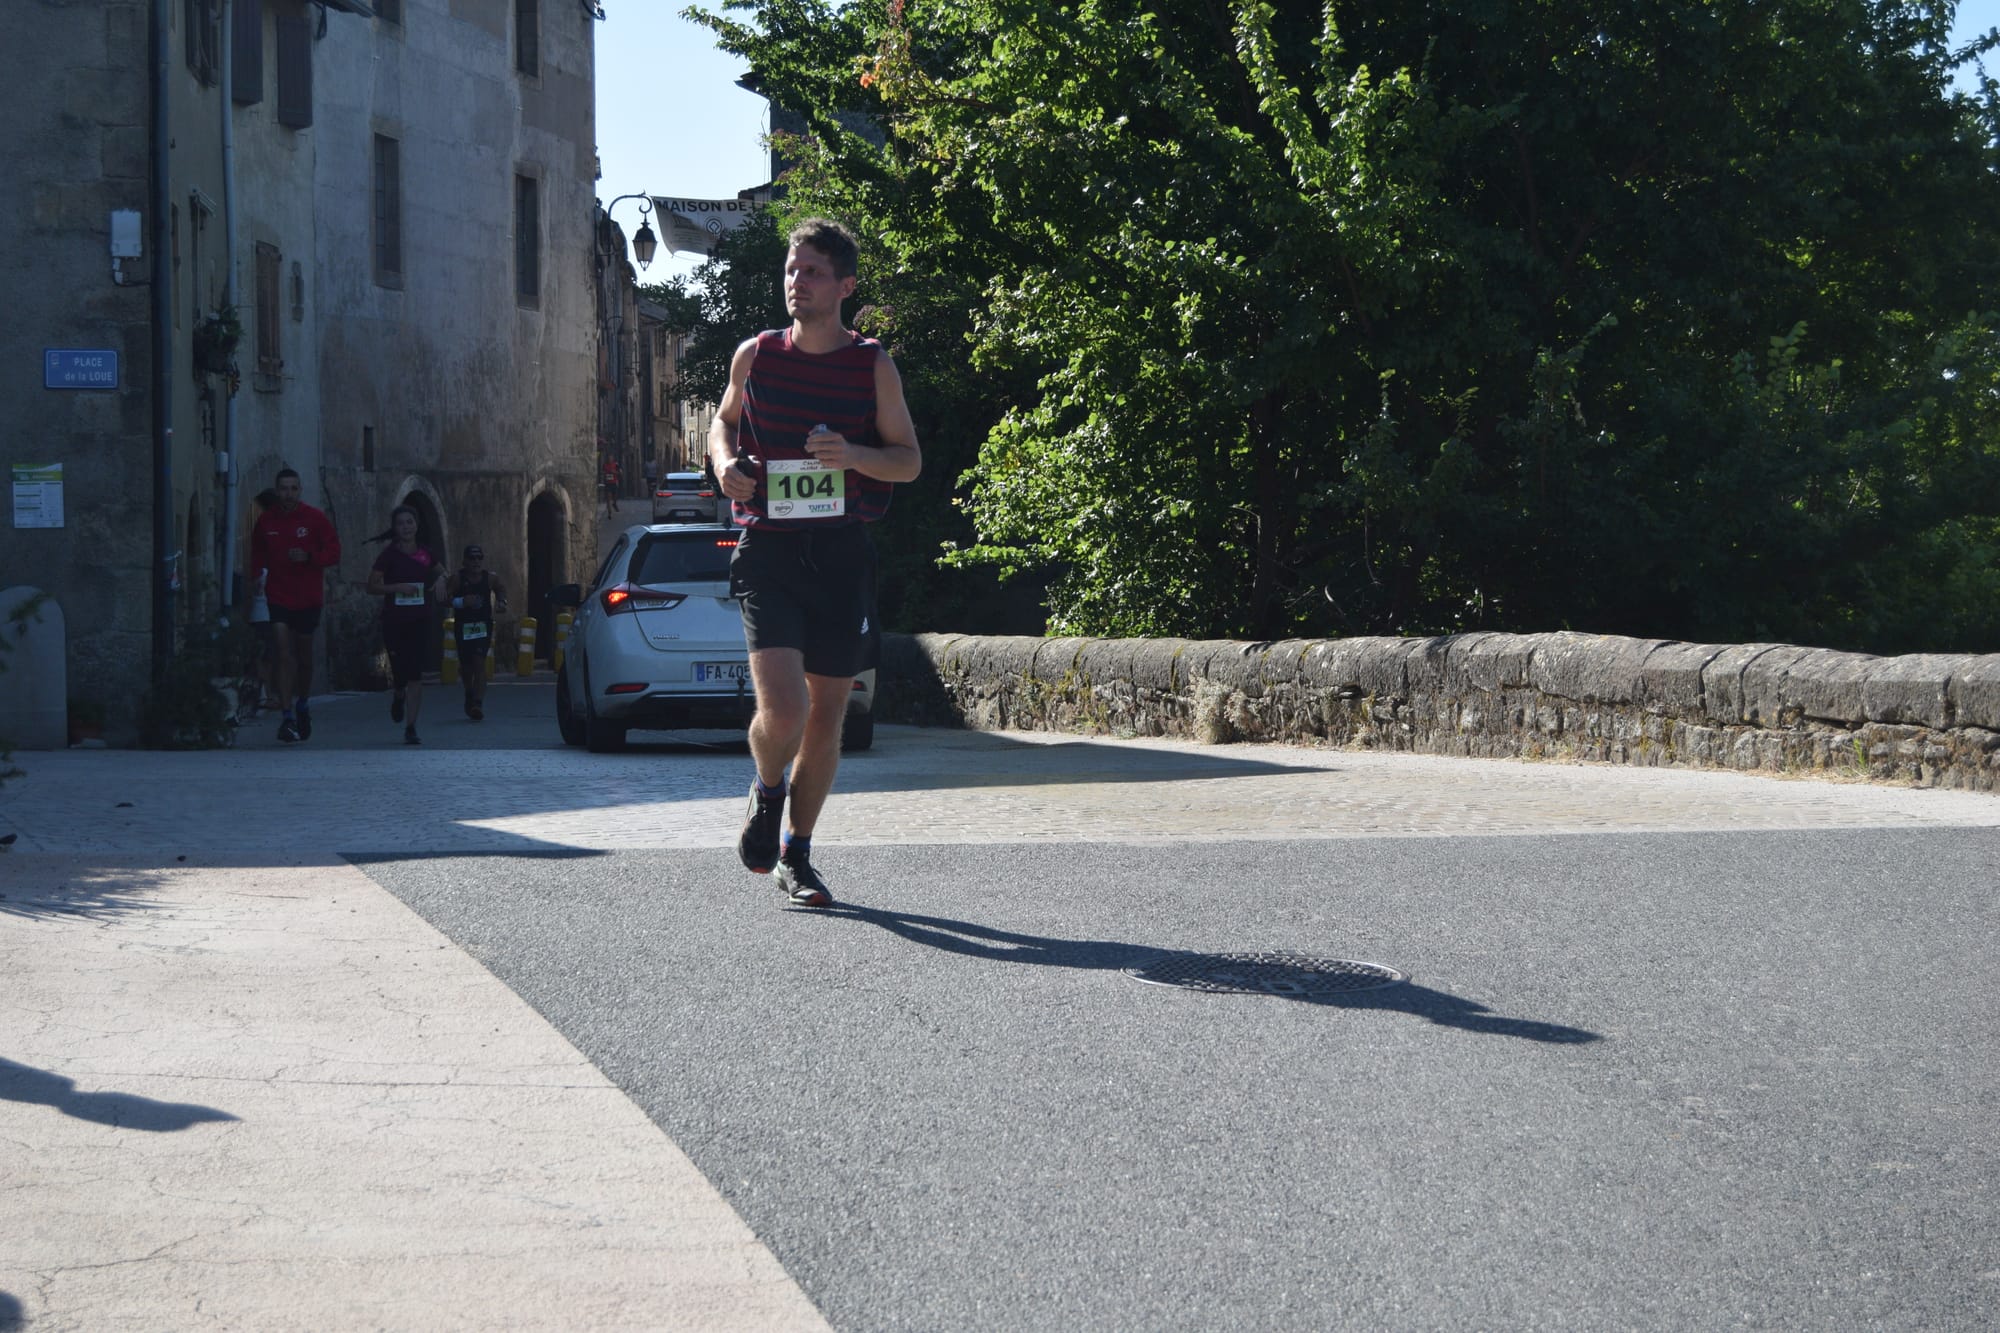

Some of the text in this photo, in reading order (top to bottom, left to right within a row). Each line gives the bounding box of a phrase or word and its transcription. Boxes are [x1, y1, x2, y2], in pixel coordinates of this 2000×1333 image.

[656, 200, 747, 212] MAISON DE
[73, 357, 103, 367] PLACE
[64, 371, 113, 381] de la LOUE
[778, 474, 834, 498] 104
